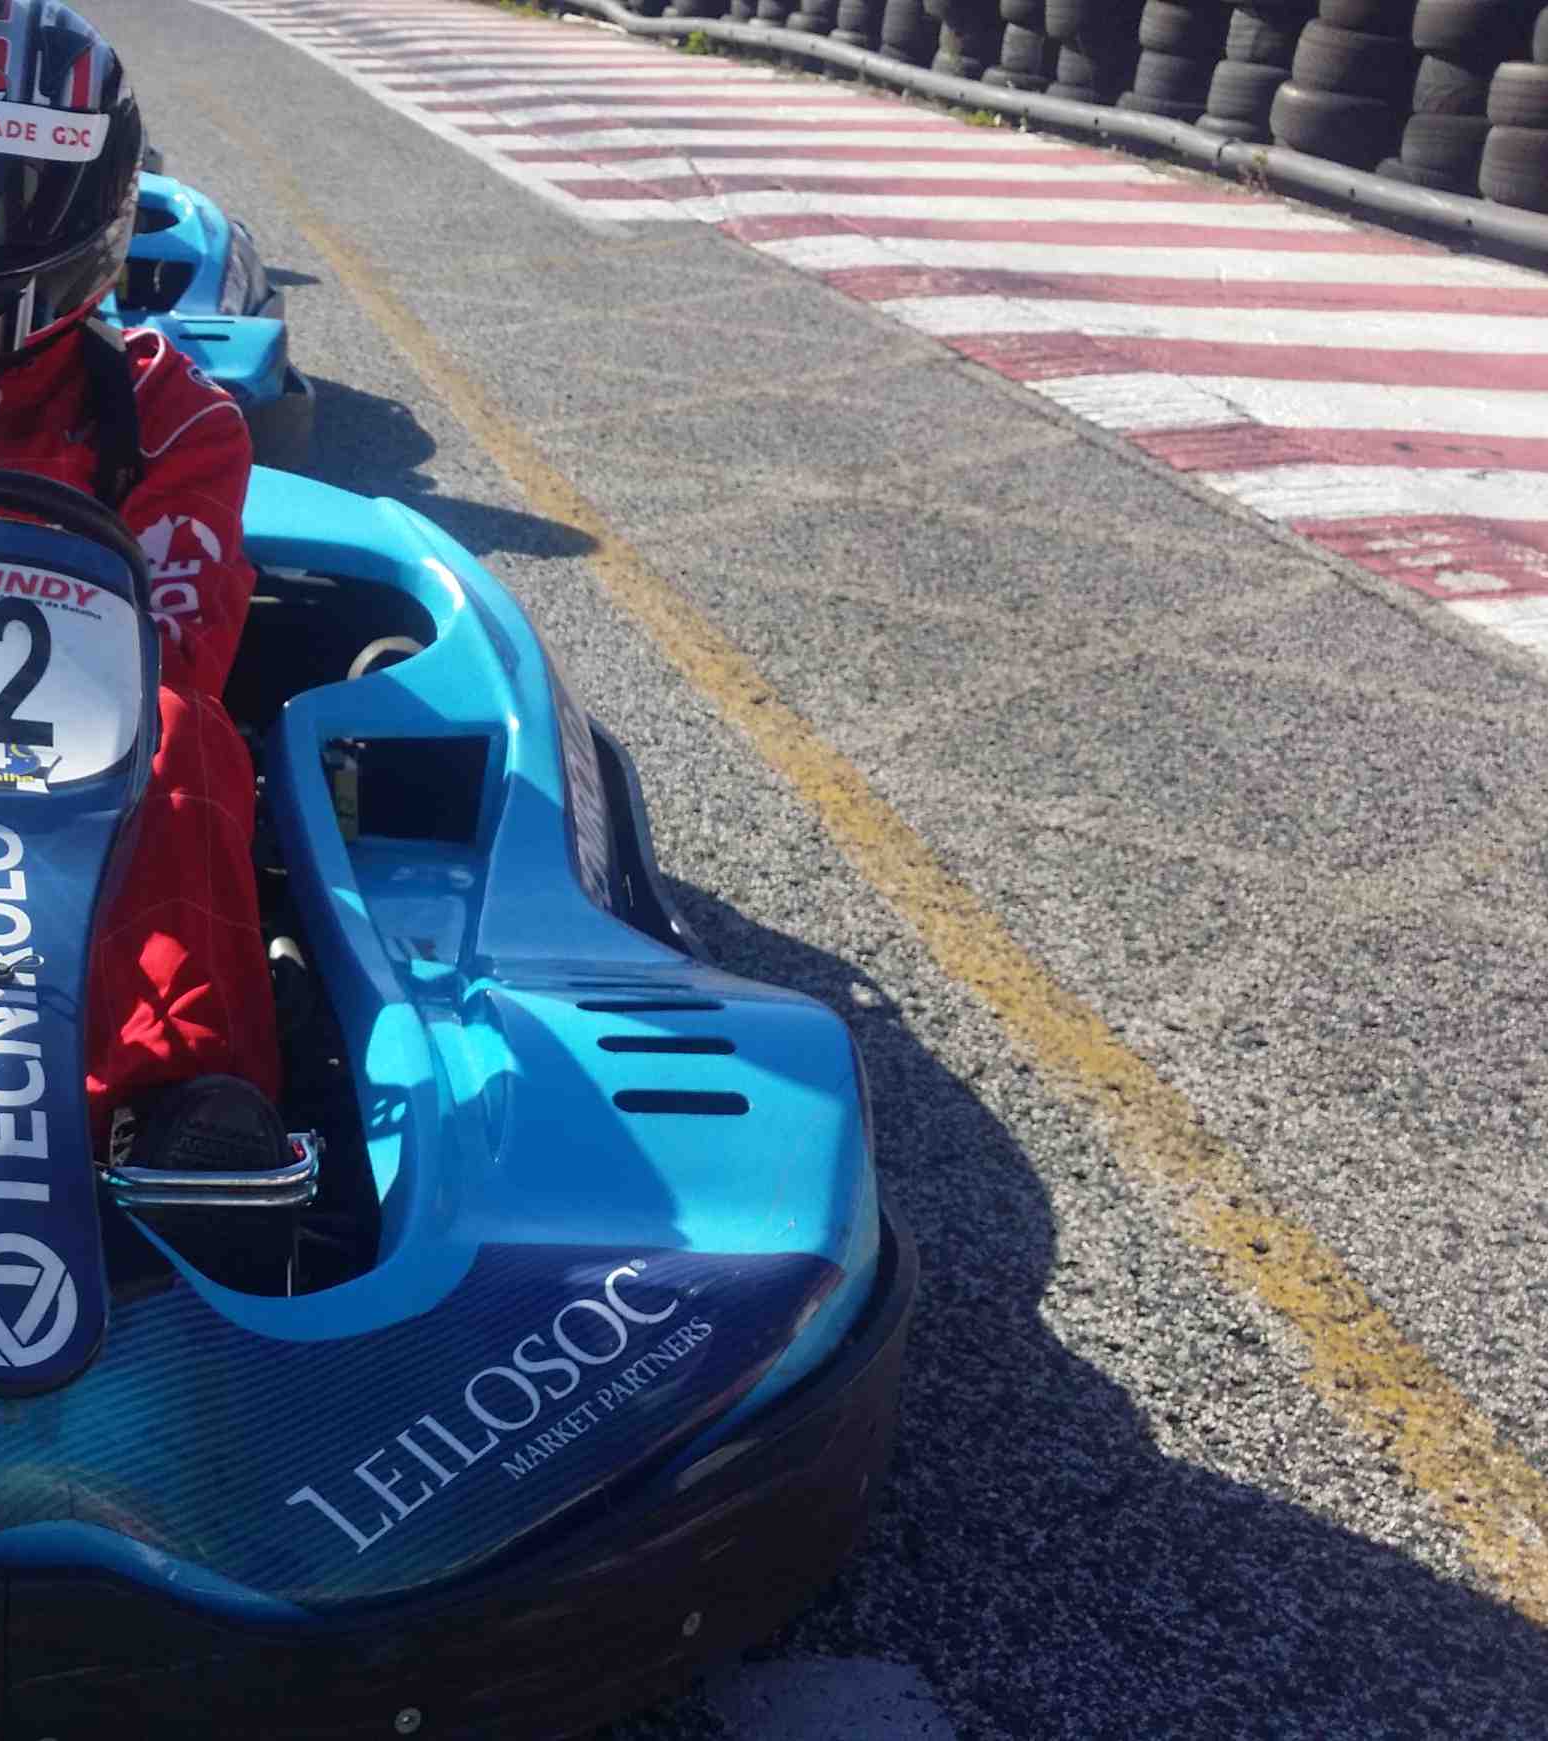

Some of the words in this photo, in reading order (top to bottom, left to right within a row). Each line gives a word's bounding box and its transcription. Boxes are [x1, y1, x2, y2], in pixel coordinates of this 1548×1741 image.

[284, 1265, 679, 1554] LEILOSOC
[500, 1403, 599, 1481] MARKET
[597, 1315, 714, 1414] PARTNERS
